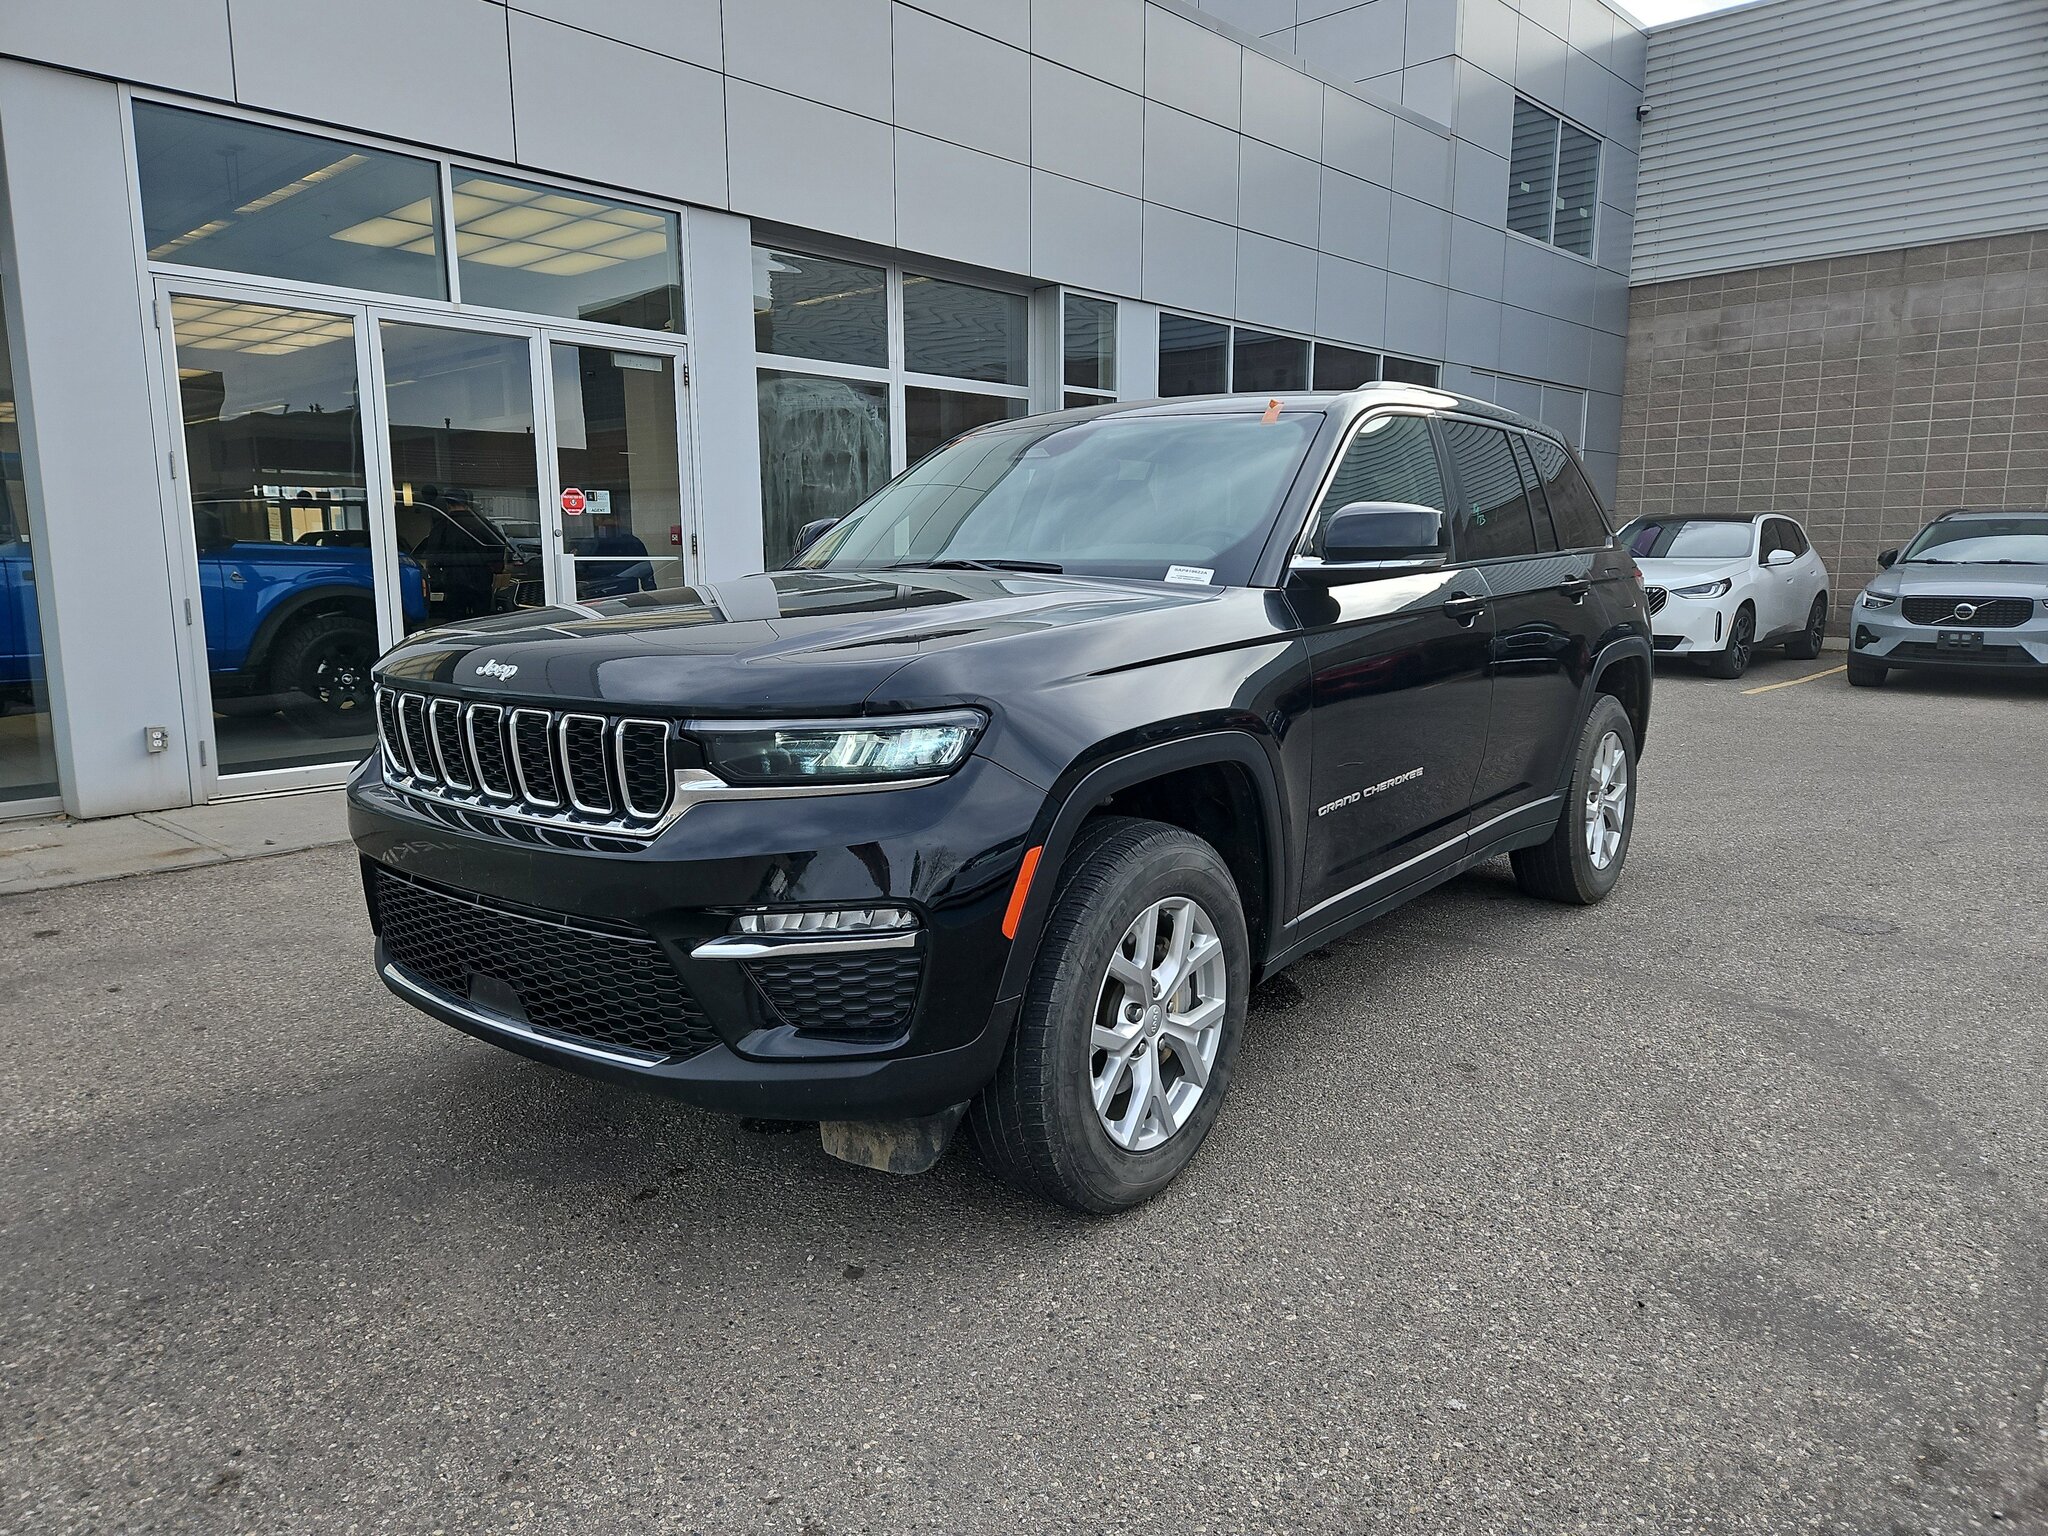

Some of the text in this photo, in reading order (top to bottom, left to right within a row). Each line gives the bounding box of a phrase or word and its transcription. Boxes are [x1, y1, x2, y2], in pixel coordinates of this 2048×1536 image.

[475, 659, 518, 681] Jeep
[1317, 766, 1424, 816] GRAND CHEROKEE
